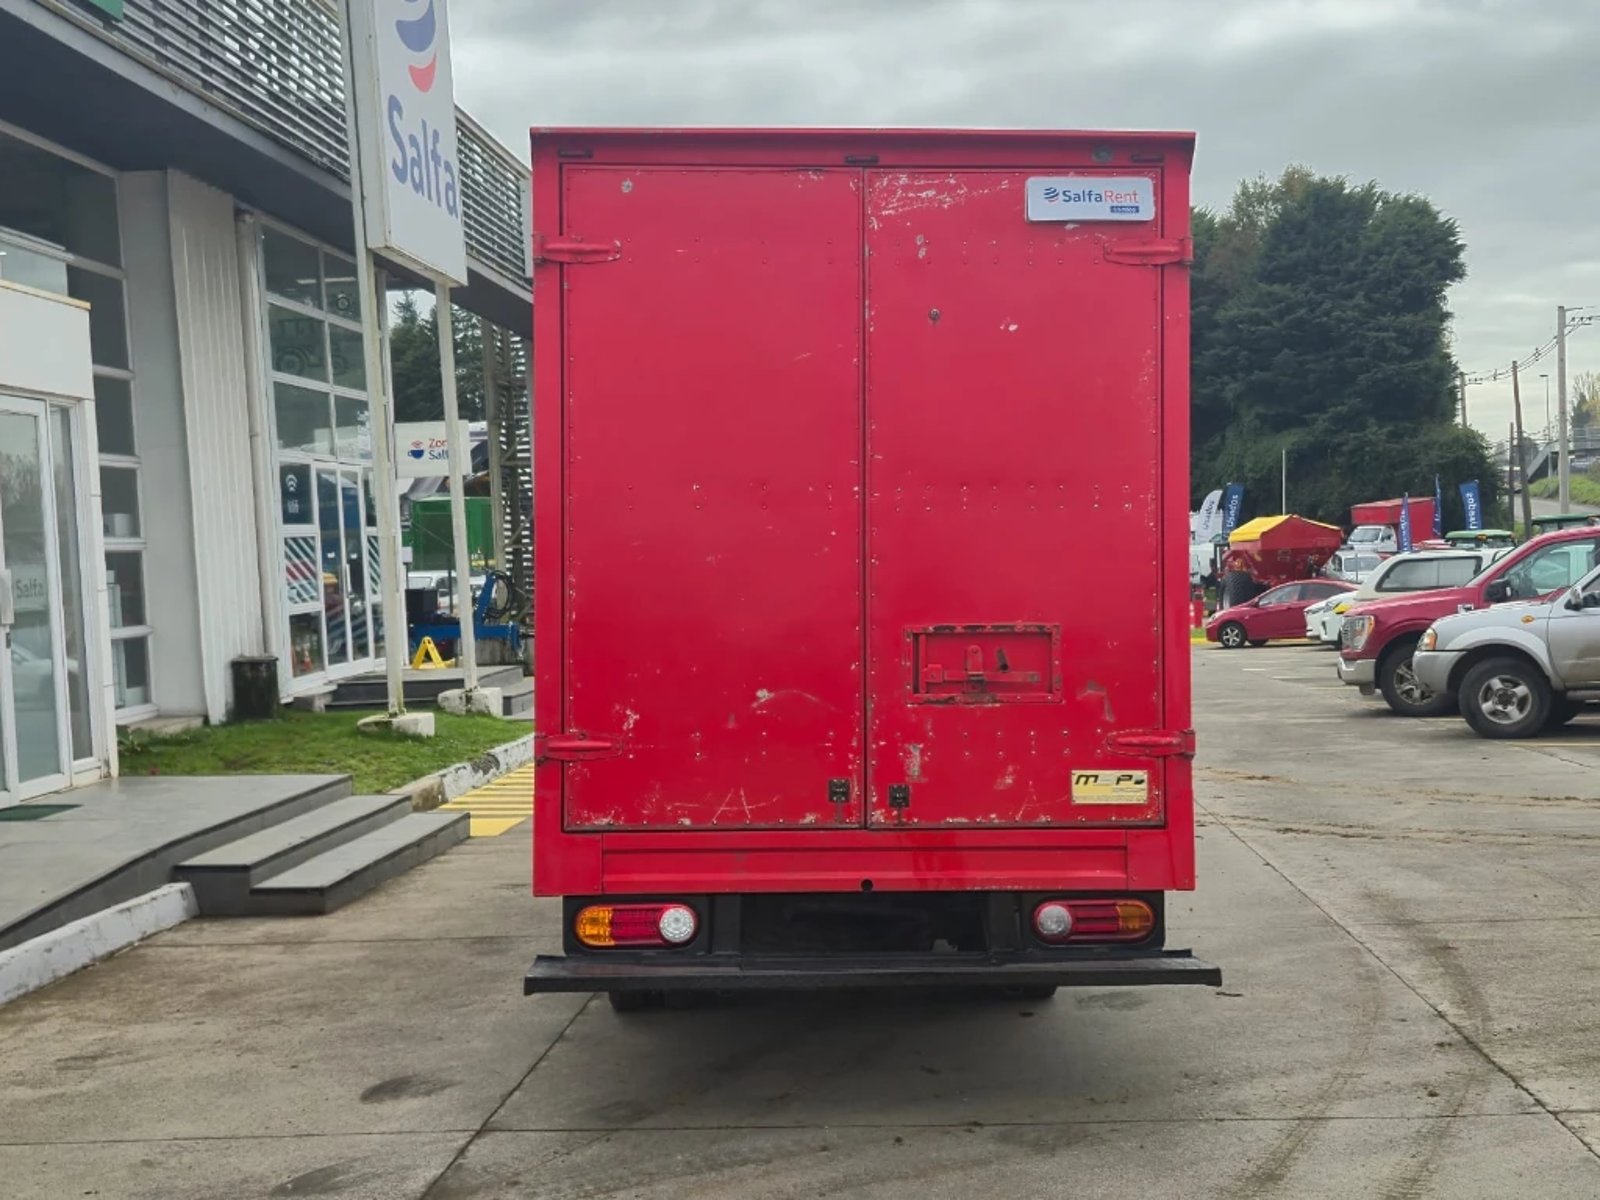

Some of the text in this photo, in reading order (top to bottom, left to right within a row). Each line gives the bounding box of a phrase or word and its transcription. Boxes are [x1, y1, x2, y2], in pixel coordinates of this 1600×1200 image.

[388, 94, 458, 219] Salfa
[1062, 189, 1139, 203] SalfaRent
[429, 438, 448, 449] Zon
[1226, 494, 1239, 528] Usados
